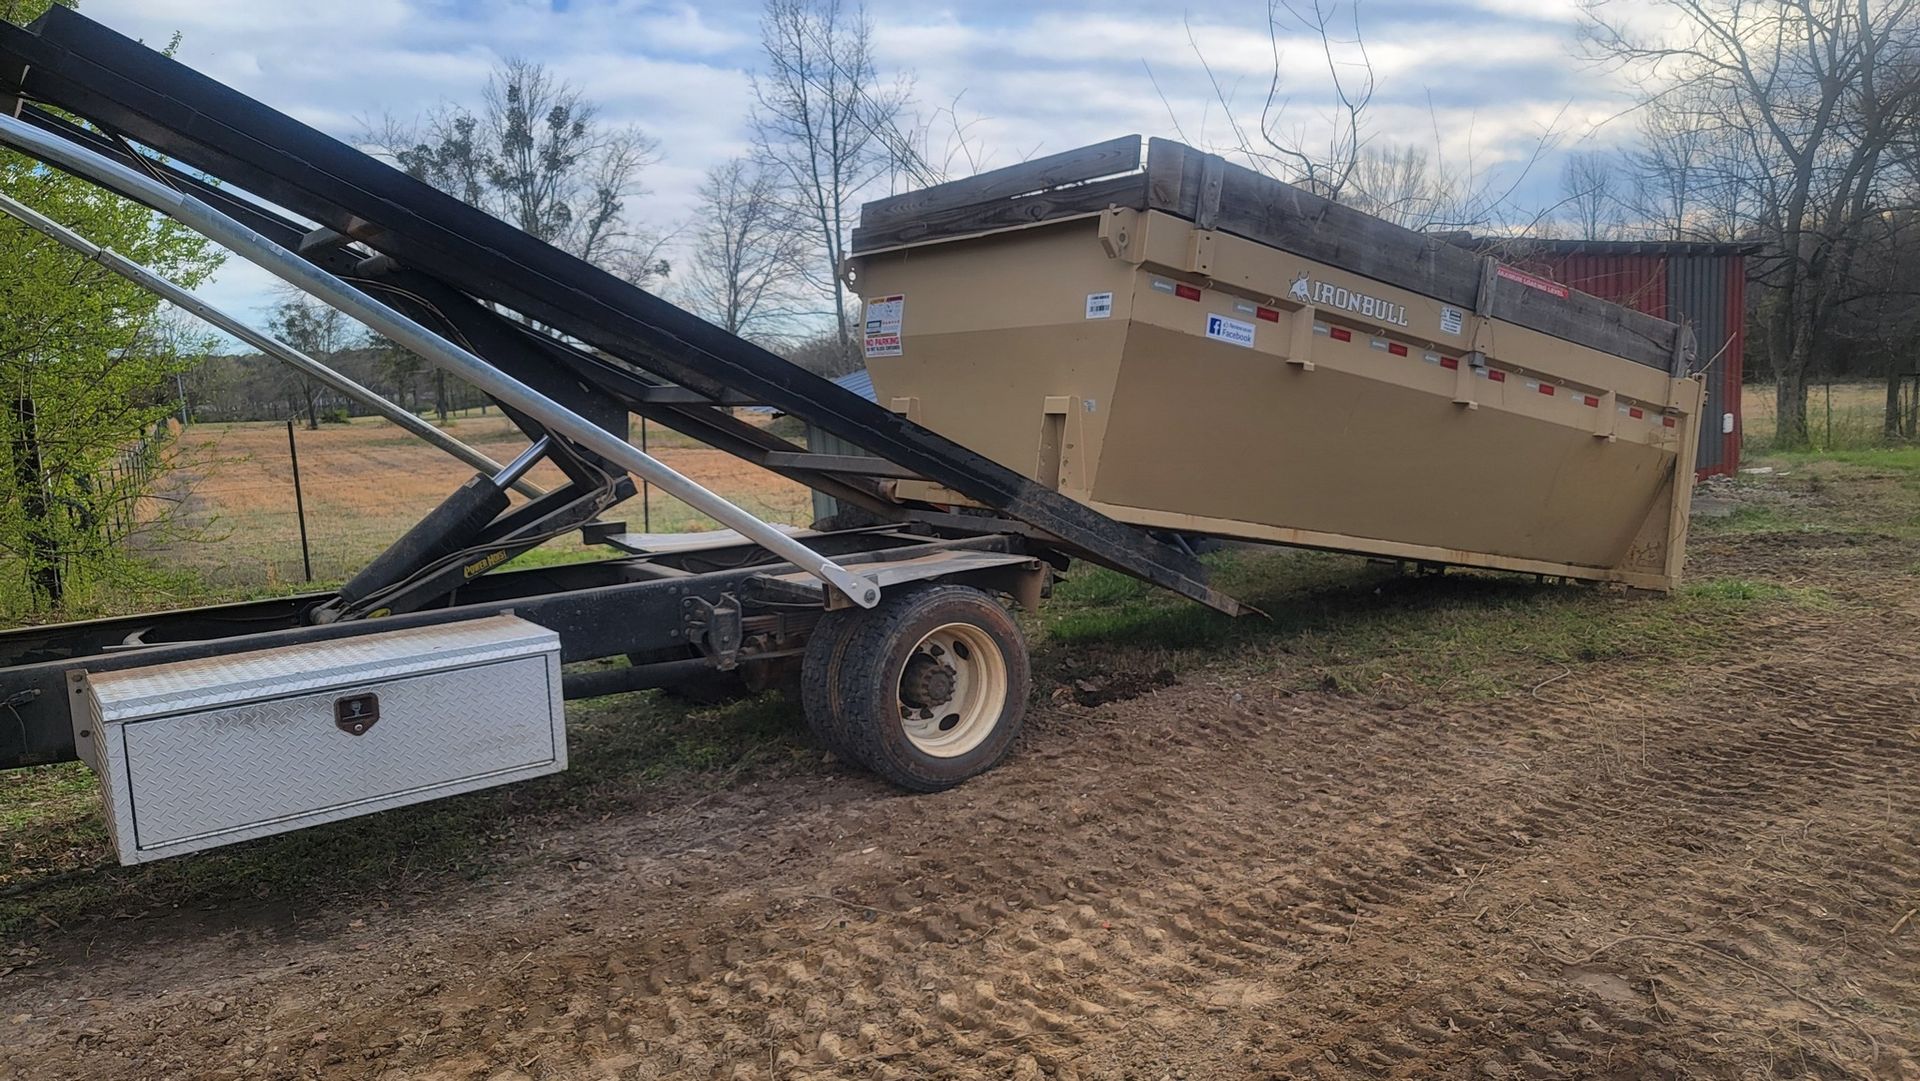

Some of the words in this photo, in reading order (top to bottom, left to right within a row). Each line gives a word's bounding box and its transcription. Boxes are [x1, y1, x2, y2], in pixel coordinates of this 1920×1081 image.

[1312, 280, 1408, 326] IRONBULL
[875, 336, 900, 346] PARKING
[1222, 328, 1252, 343] Facebook
[463, 558, 489, 579] POWER
